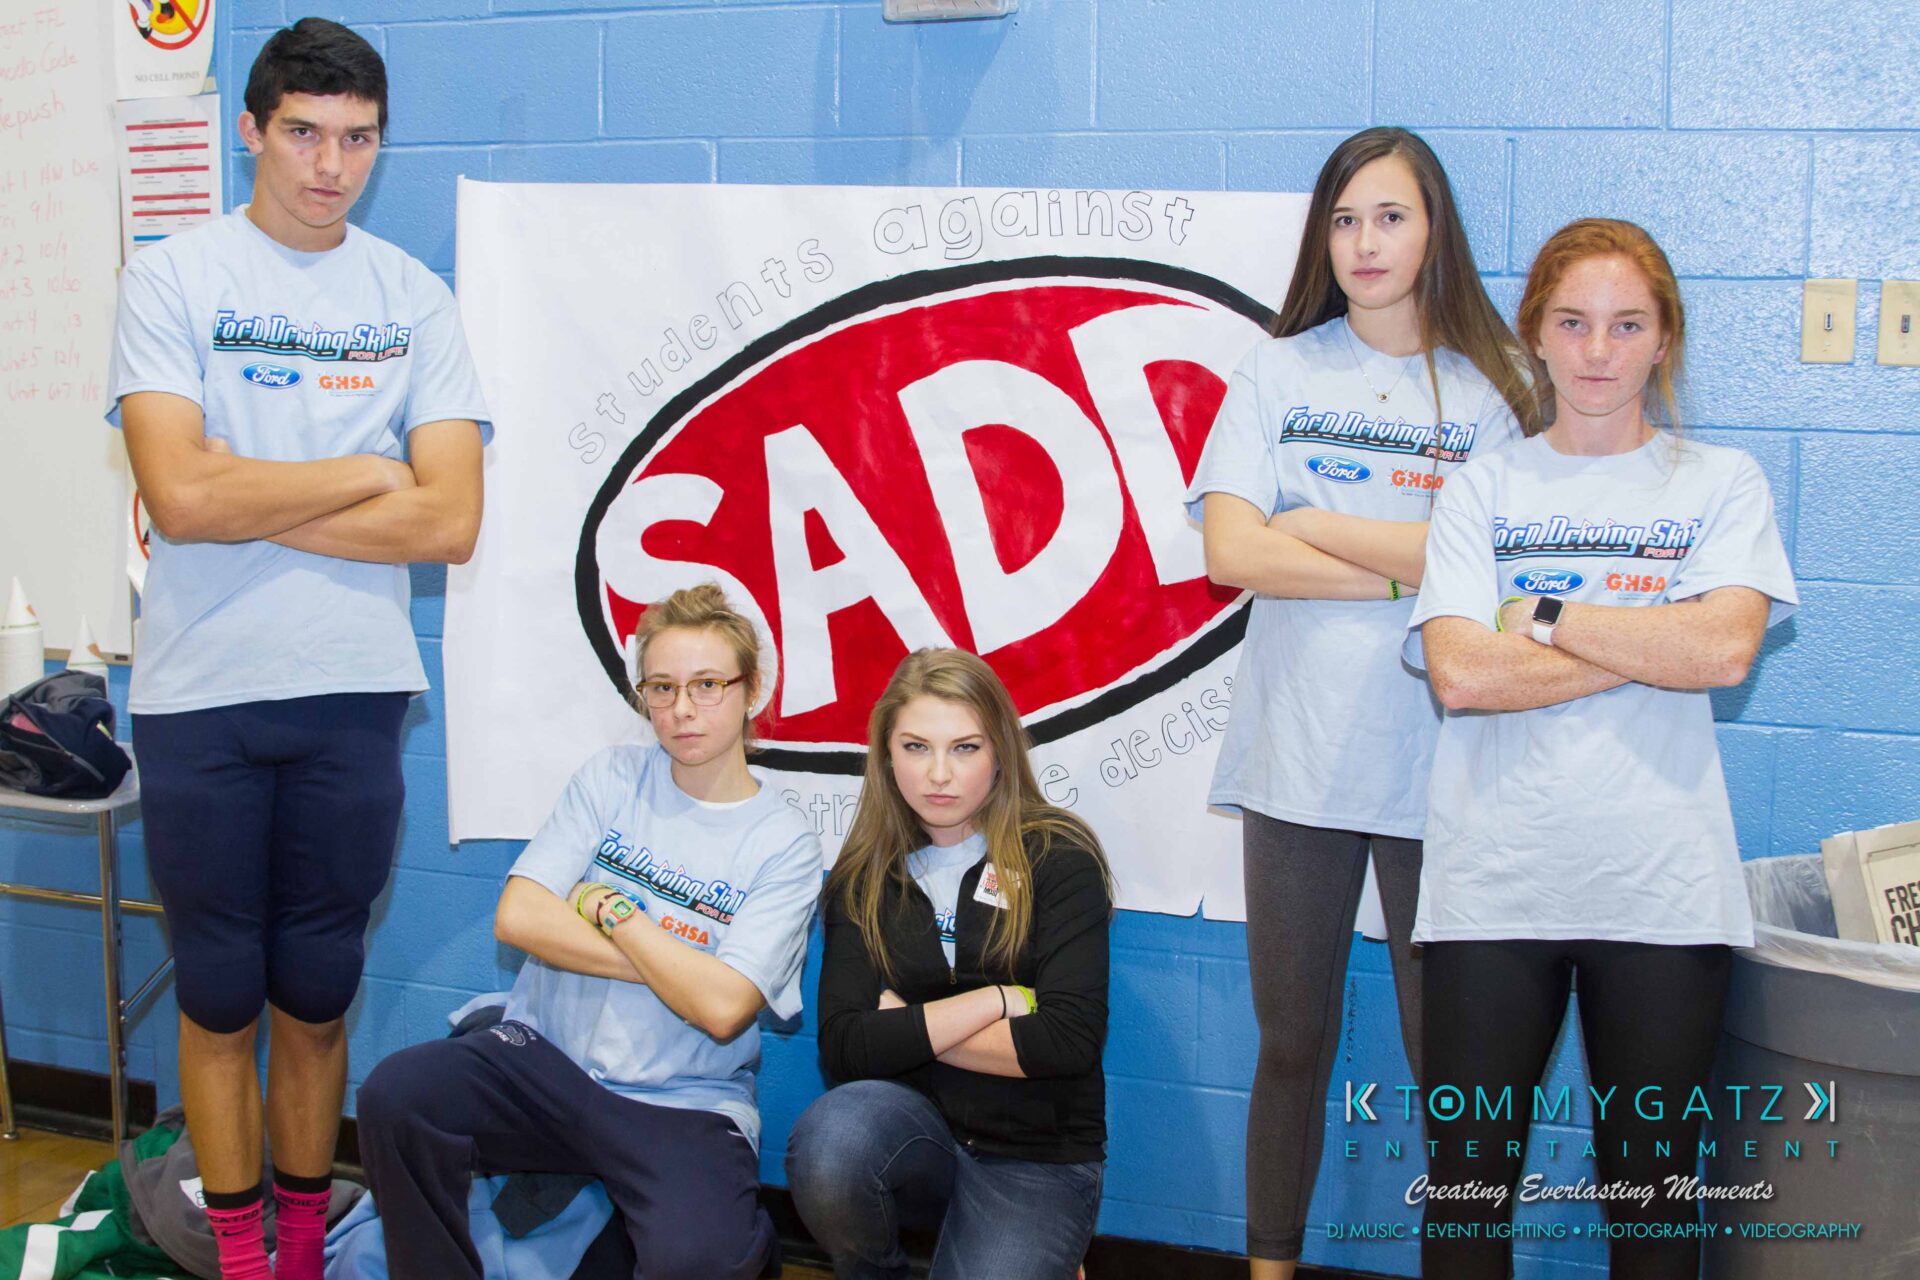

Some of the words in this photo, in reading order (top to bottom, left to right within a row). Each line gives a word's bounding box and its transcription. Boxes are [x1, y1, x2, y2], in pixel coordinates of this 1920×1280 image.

[267, 315, 347, 356] Driving
[350, 322, 411, 352] Skills
[567, 237, 835, 465] students
[872, 190, 1195, 260] against
[252, 364, 290, 386] Ford
[318, 374, 376, 390] GHSA
[1340, 411, 1430, 452] Driving
[1316, 457, 1360, 480] Ford
[596, 303, 1265, 720] SADD
[1542, 515, 1646, 556] Driving
[1525, 570, 1571, 591] Ford
[1606, 573, 1666, 592] GHSA
[629, 846, 706, 906] Driving
[1884, 880, 1920, 914] FRE
[660, 914, 709, 945] GHSA
